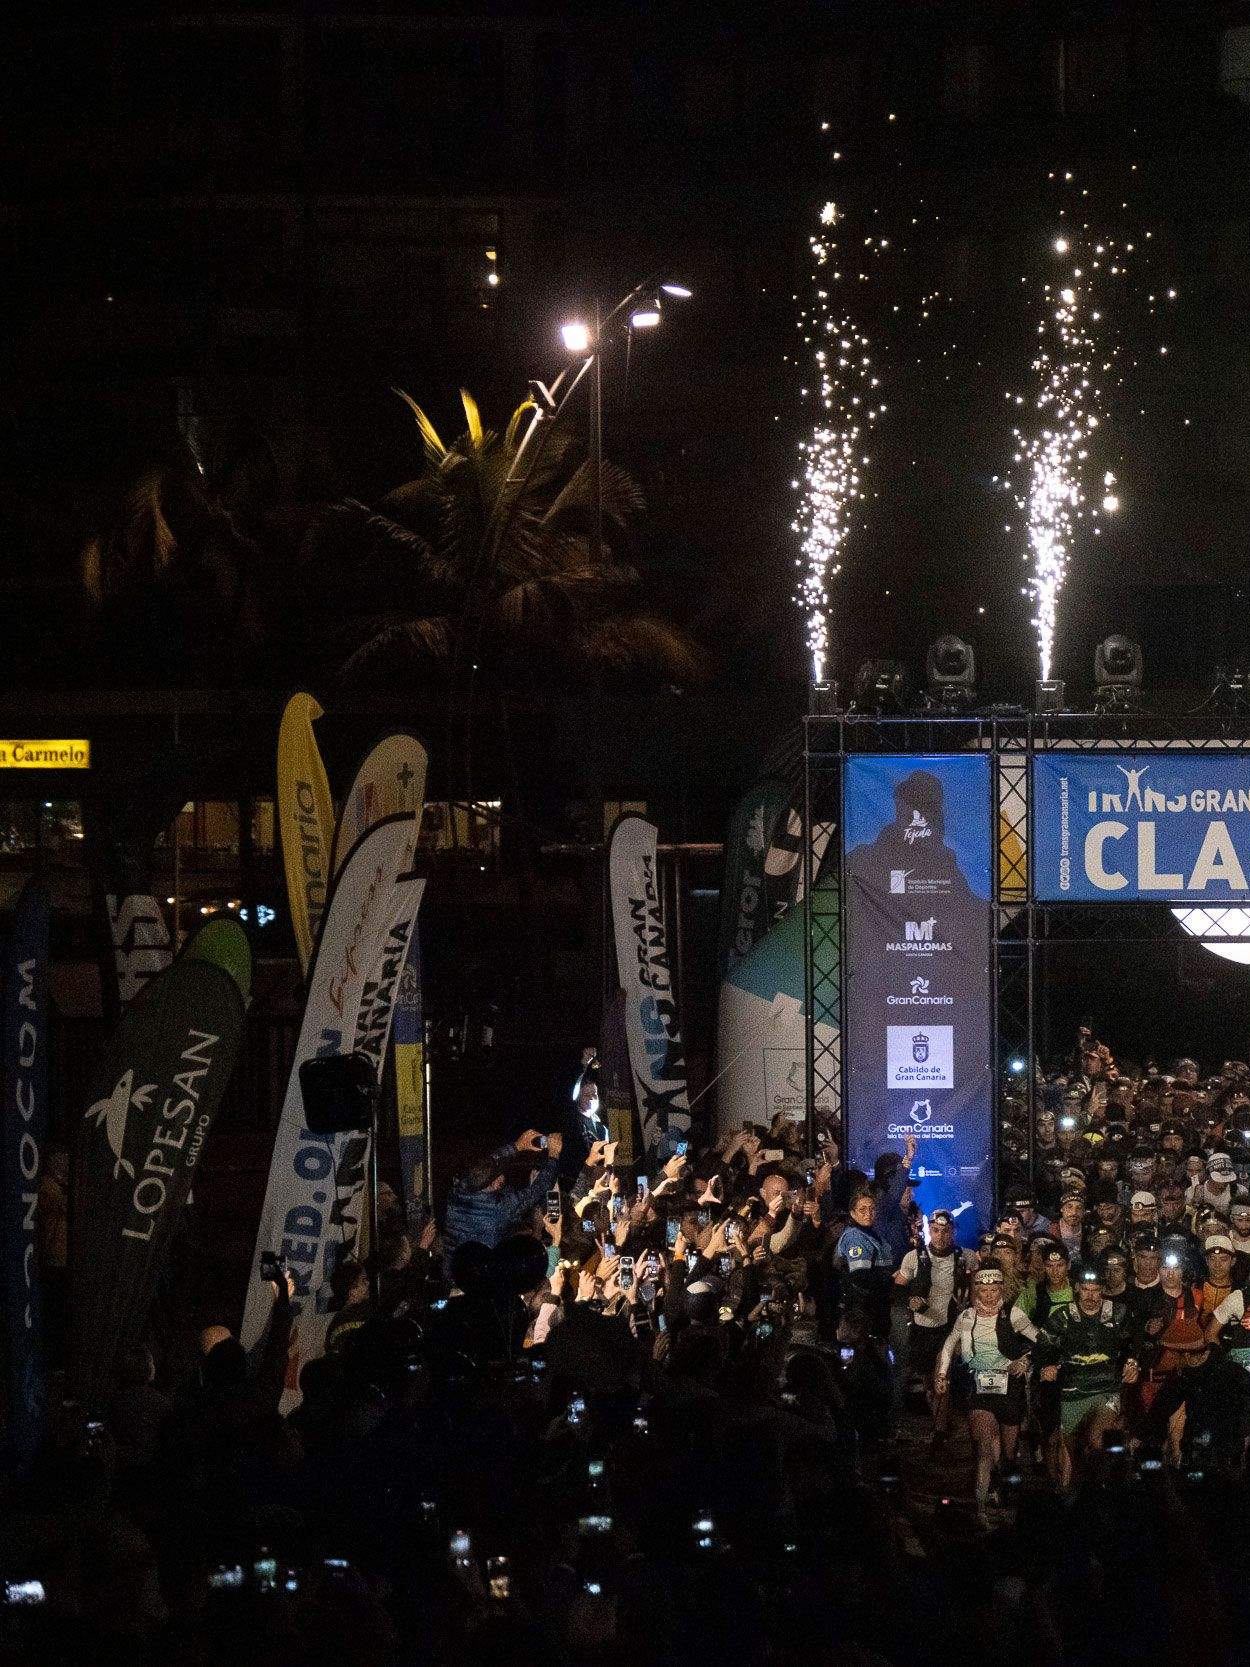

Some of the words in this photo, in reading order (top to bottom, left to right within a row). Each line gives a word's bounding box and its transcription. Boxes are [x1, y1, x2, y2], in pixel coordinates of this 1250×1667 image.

[13, 743, 84, 762] Carmelo
[293, 780, 328, 932] anaria
[361, 919, 411, 1060] ANARIA
[886, 942, 953, 951] MASPALOMAS
[121, 1028, 221, 1242] LOPESAN
[185, 1114, 210, 1168] GRUPO
